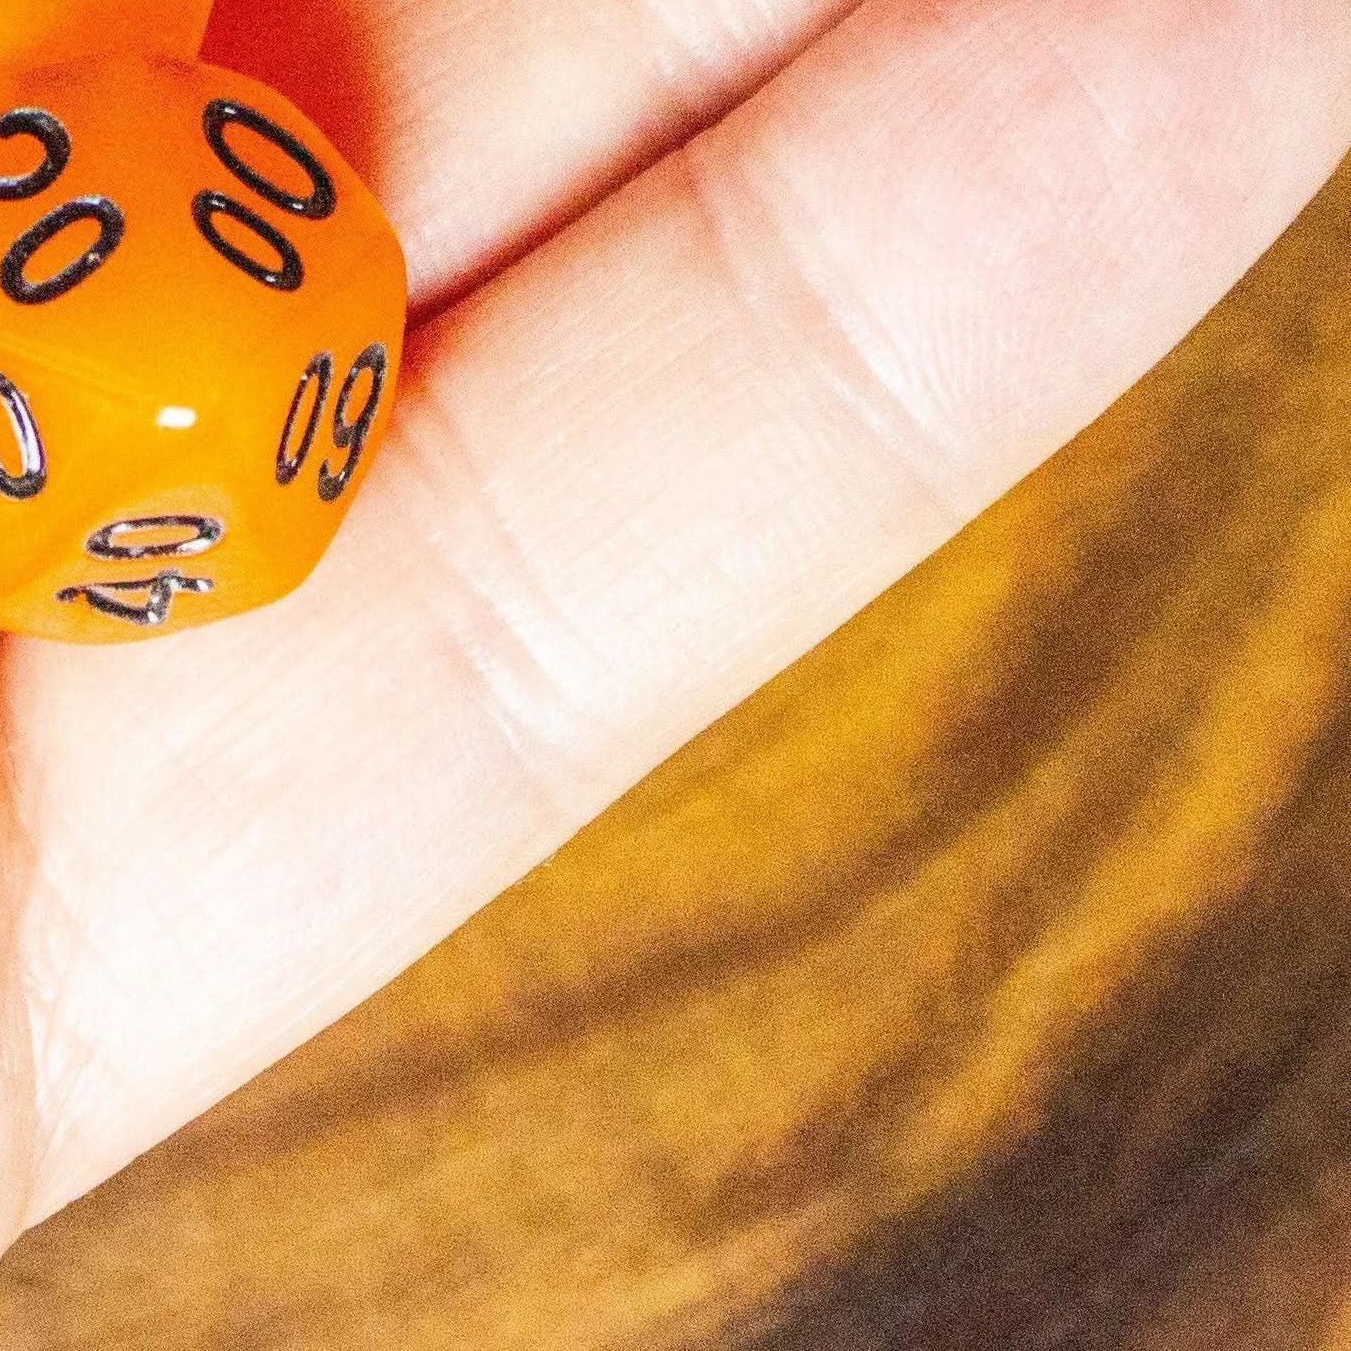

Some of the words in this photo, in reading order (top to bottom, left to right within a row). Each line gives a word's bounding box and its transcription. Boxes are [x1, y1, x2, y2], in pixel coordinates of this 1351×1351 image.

[191, 97, 338, 294] 00
[274, 342, 388, 504] 60
[55, 514, 222, 626] 40
